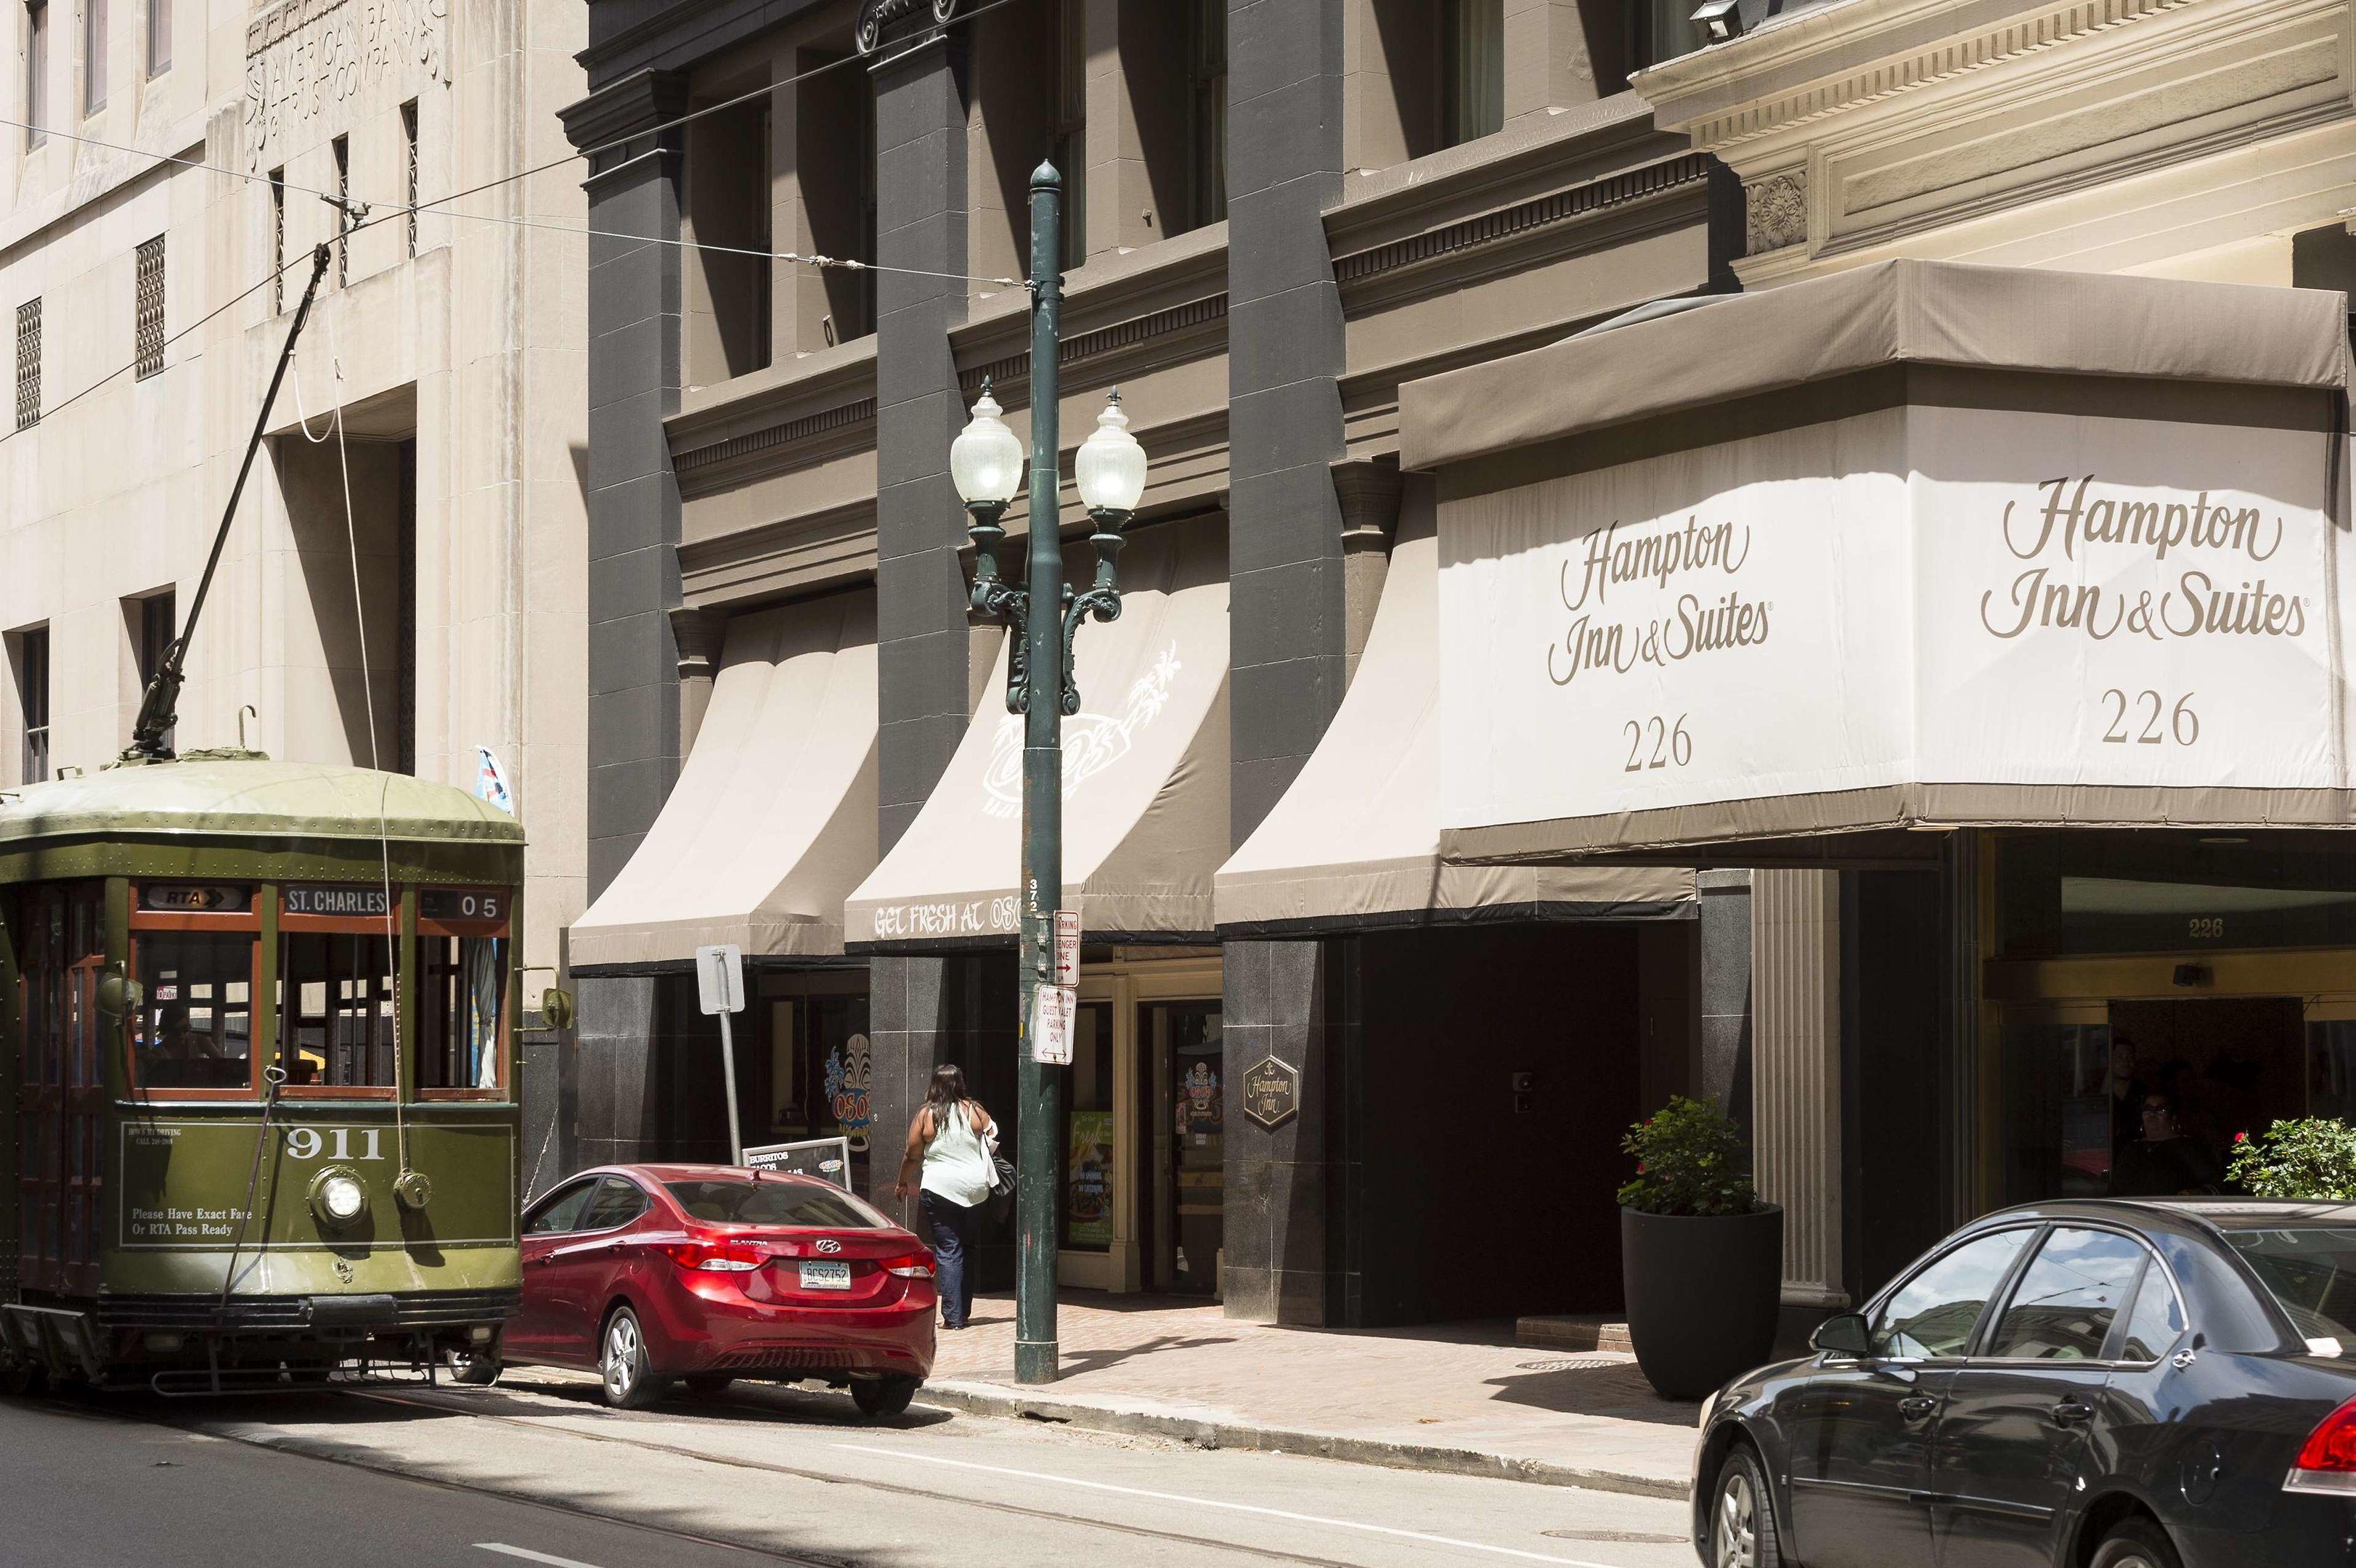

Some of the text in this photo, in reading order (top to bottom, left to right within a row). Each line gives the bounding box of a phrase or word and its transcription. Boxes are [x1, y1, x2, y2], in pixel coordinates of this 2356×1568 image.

[271, 19, 364, 99] AMERICAN
[334, 26, 416, 102] COMPANY
[2003, 473, 2283, 562] Hampton
[1562, 514, 1750, 611] Hampton
[1981, 567, 2305, 640] Inn & Suites
[1548, 590, 1769, 686] Inn & Suites
[2101, 688, 2199, 746] 226
[1623, 713, 1692, 772] 226
[166, 891, 202, 905] RTA
[288, 890, 386, 912] ST. CHARLES
[874, 906, 908, 939] GET
[910, 903, 957, 935] FRESH
[960, 900, 985, 932] AT
[2189, 918, 2223, 938] 226
[1043, 1005, 1057, 1016] GUEST
[1047, 1018, 1066, 1031] PARKING
[1049, 1032, 1061, 1043] ONLY
[1247, 1074, 1292, 1098] Hampton
[1258, 1093, 1279, 1116] Inn
[287, 1127, 385, 1160] 911
[749, 1151, 788, 1164] BURRITOS
[132, 1208, 164, 1220] Please
[168, 1208, 193, 1220] Have
[197, 1208, 227, 1220] Exact
[132, 1223, 234, 1236] Or RTA Pass Ready
